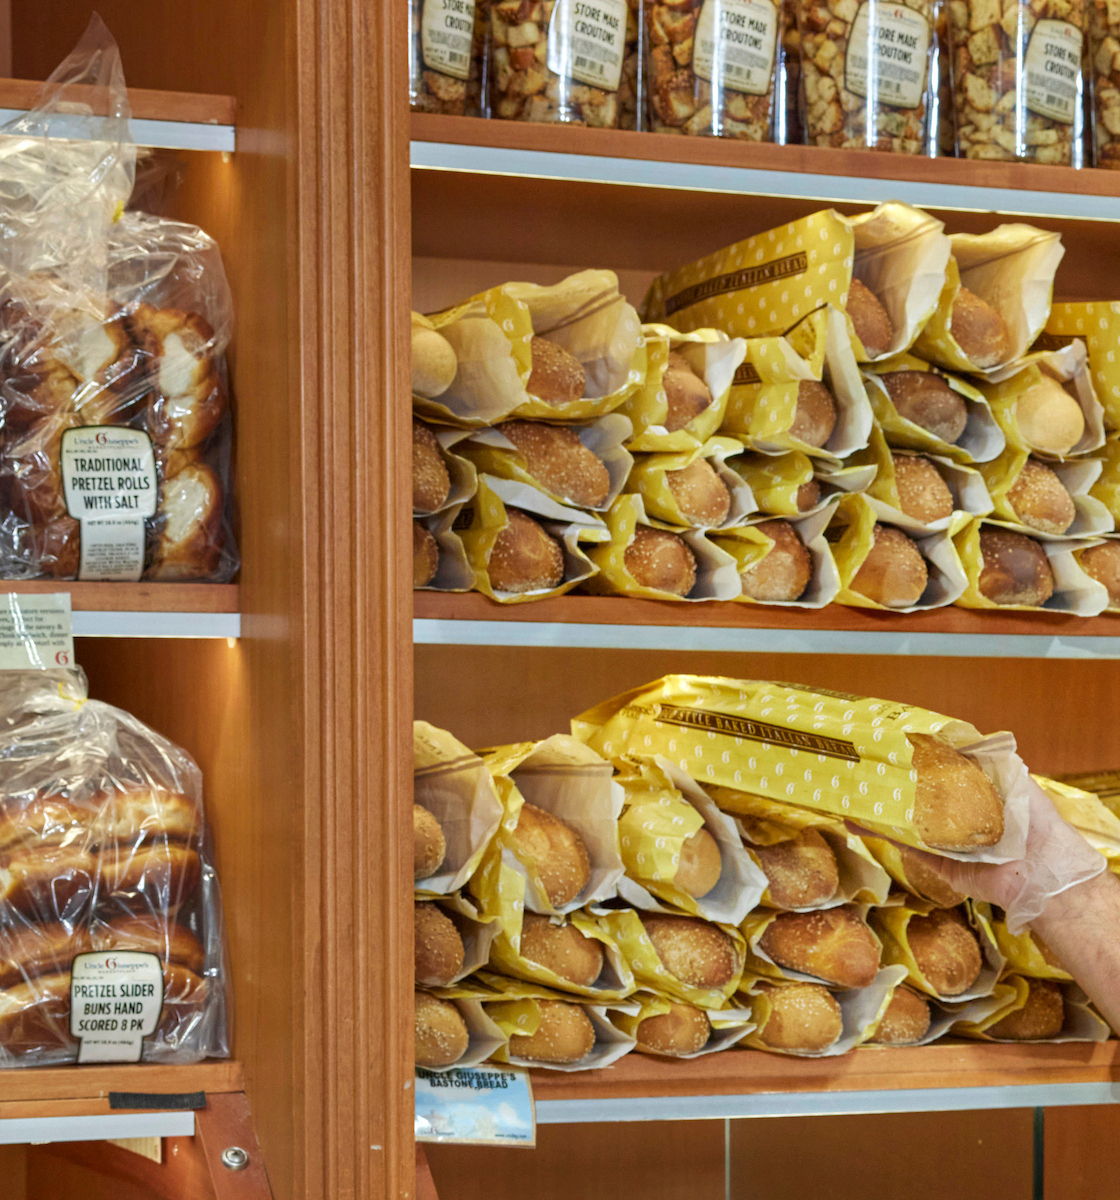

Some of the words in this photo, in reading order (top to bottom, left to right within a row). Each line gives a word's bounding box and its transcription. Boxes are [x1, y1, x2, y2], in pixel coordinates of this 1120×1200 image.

[575, 2, 600, 20] STORE
[603, 12, 620, 31] MADE
[720, 9, 746, 29] STORE
[748, 16, 767, 34] MADE
[575, 20, 616, 46] CROUTONS
[897, 31, 918, 49] MADE
[73, 458, 144, 472] TRADITIONAL
[72, 477, 115, 491] PRETZEL
[118, 476, 150, 490] ROLLS
[84, 496, 112, 509] WITH
[115, 495, 139, 509] SALT
[679, 709, 711, 727] STYLE
[716, 717, 756, 735] BAKED
[762, 723, 811, 748] ITALIAN
[74, 984, 117, 998] PRETZEL
[120, 984, 155, 997] SLIDER
[84, 1002, 111, 1015] BUNS
[114, 1002, 143, 1015] HAND
[78, 1018, 118, 1031] SCORED
[121, 1019, 128, 1031] 8
[130, 1018, 144, 1031] PK
[456, 1070, 517, 1081] GIUSEPPE'S
[430, 1078, 474, 1089] BASTONE
